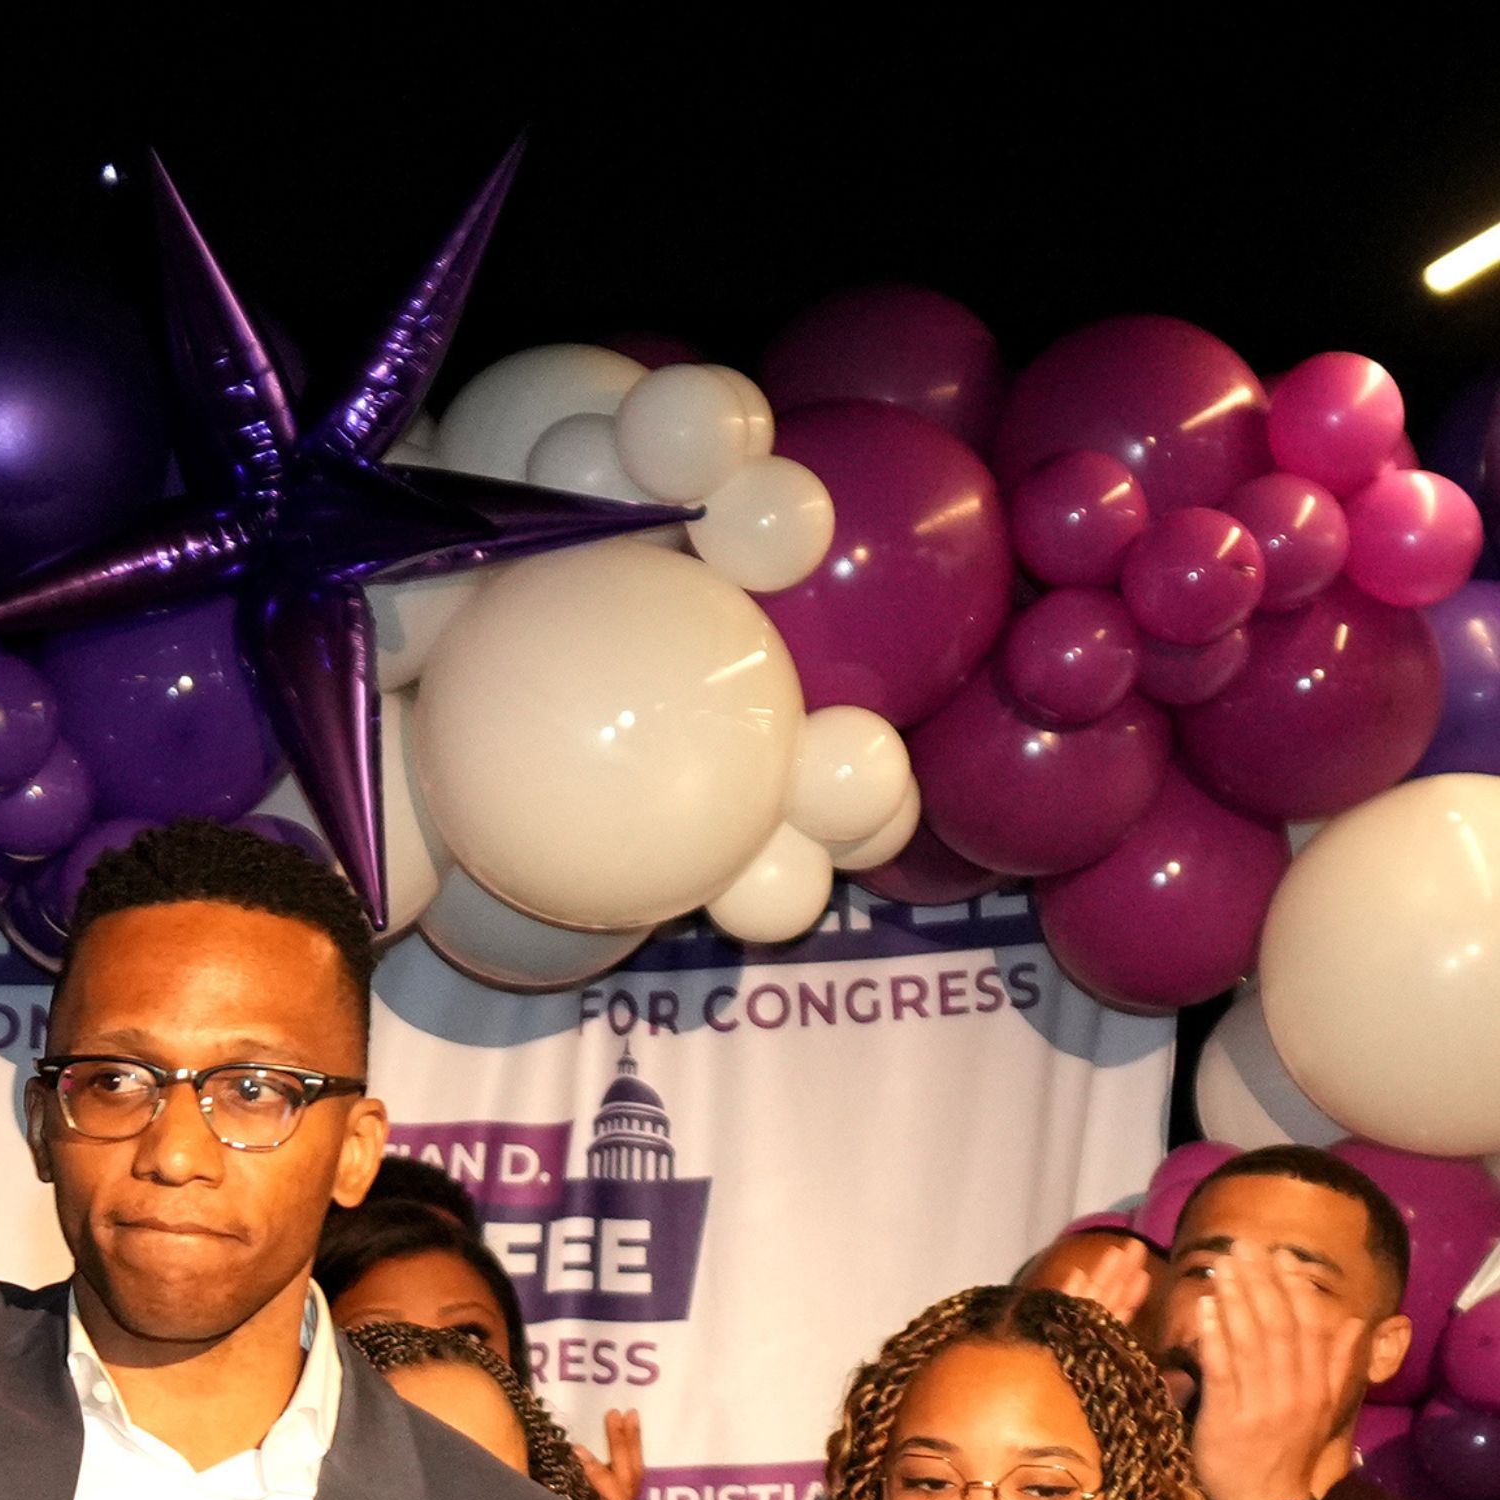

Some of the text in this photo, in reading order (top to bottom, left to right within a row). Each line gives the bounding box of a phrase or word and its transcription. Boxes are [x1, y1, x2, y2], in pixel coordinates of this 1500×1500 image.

[579, 961, 1042, 1037] FOR CONGRESS
[500, 1143, 551, 1185] D.
[530, 1337, 660, 1387] RESS
